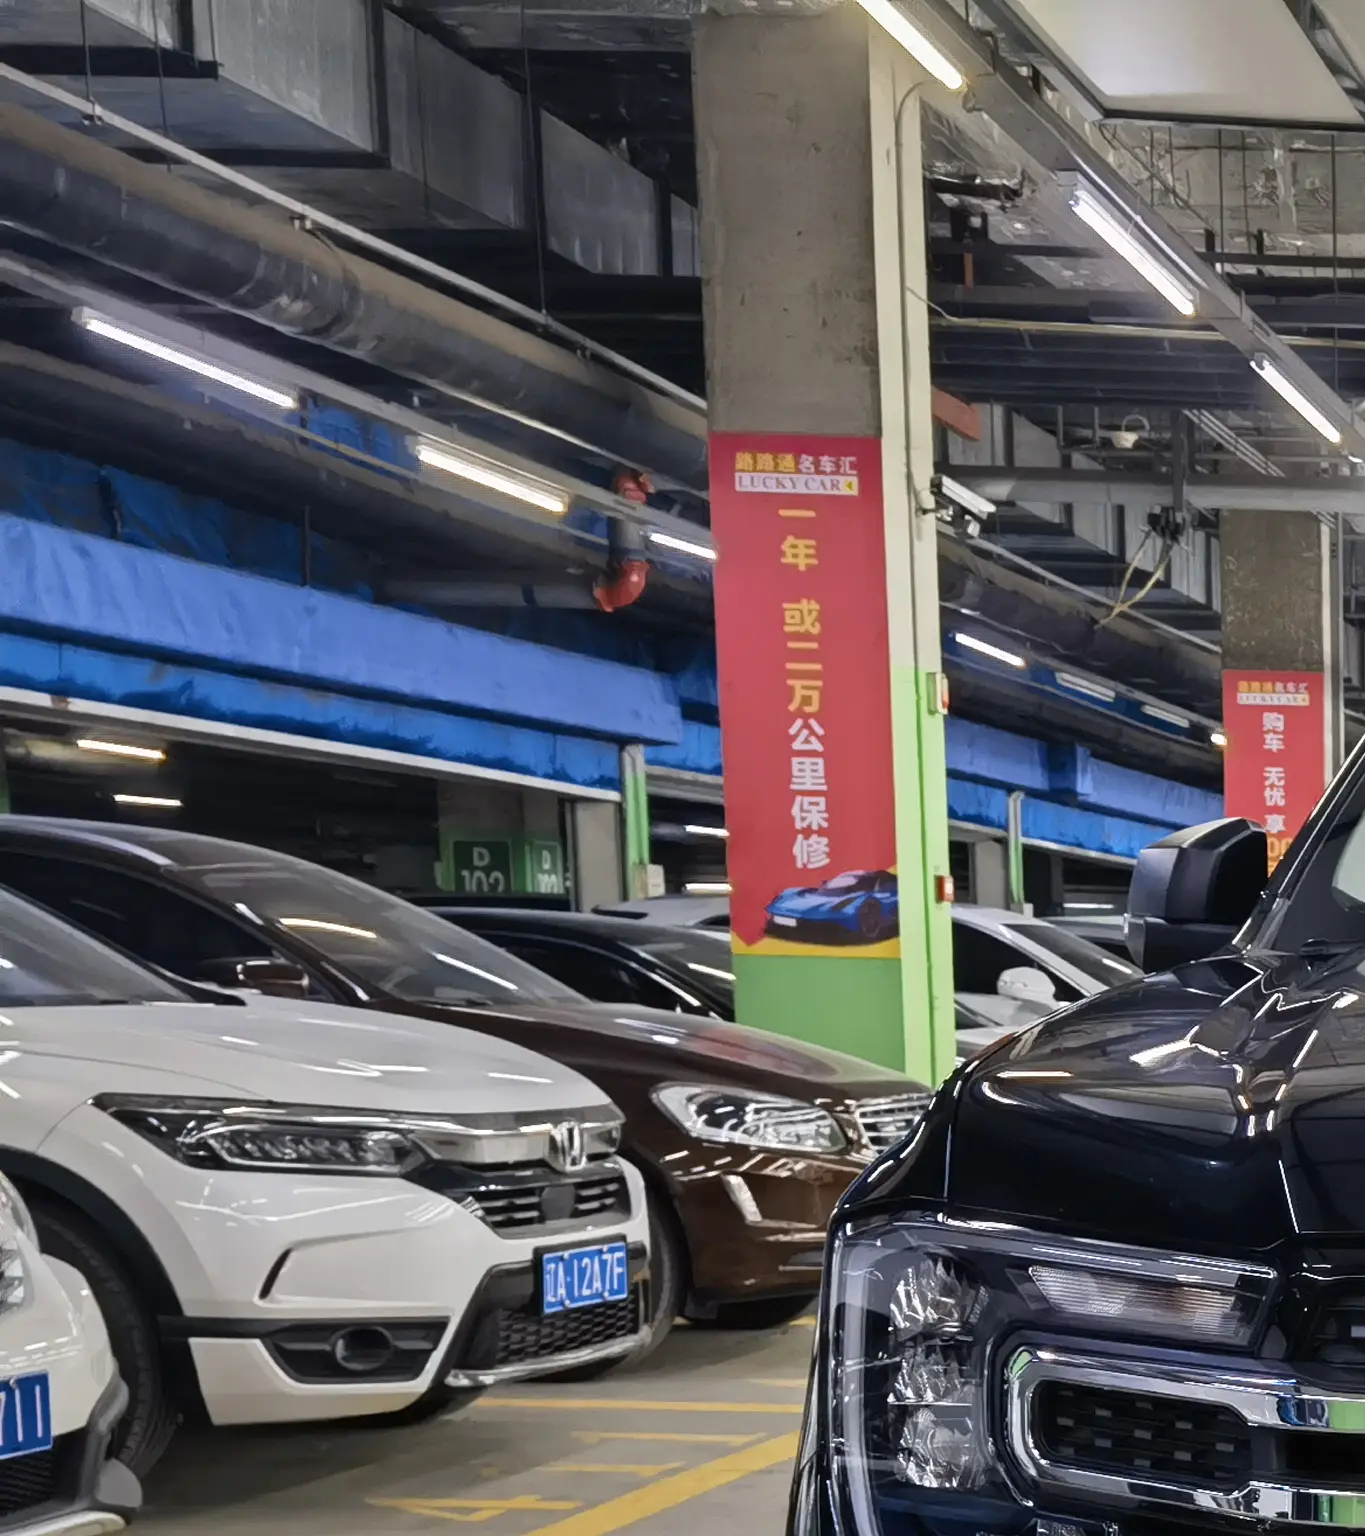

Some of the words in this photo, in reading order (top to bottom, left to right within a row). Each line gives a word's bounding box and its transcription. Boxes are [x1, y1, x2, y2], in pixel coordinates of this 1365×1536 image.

[738, 475, 799, 491] LUCKY
[804, 477, 841, 492] CAR
[473, 847, 490, 867] D
